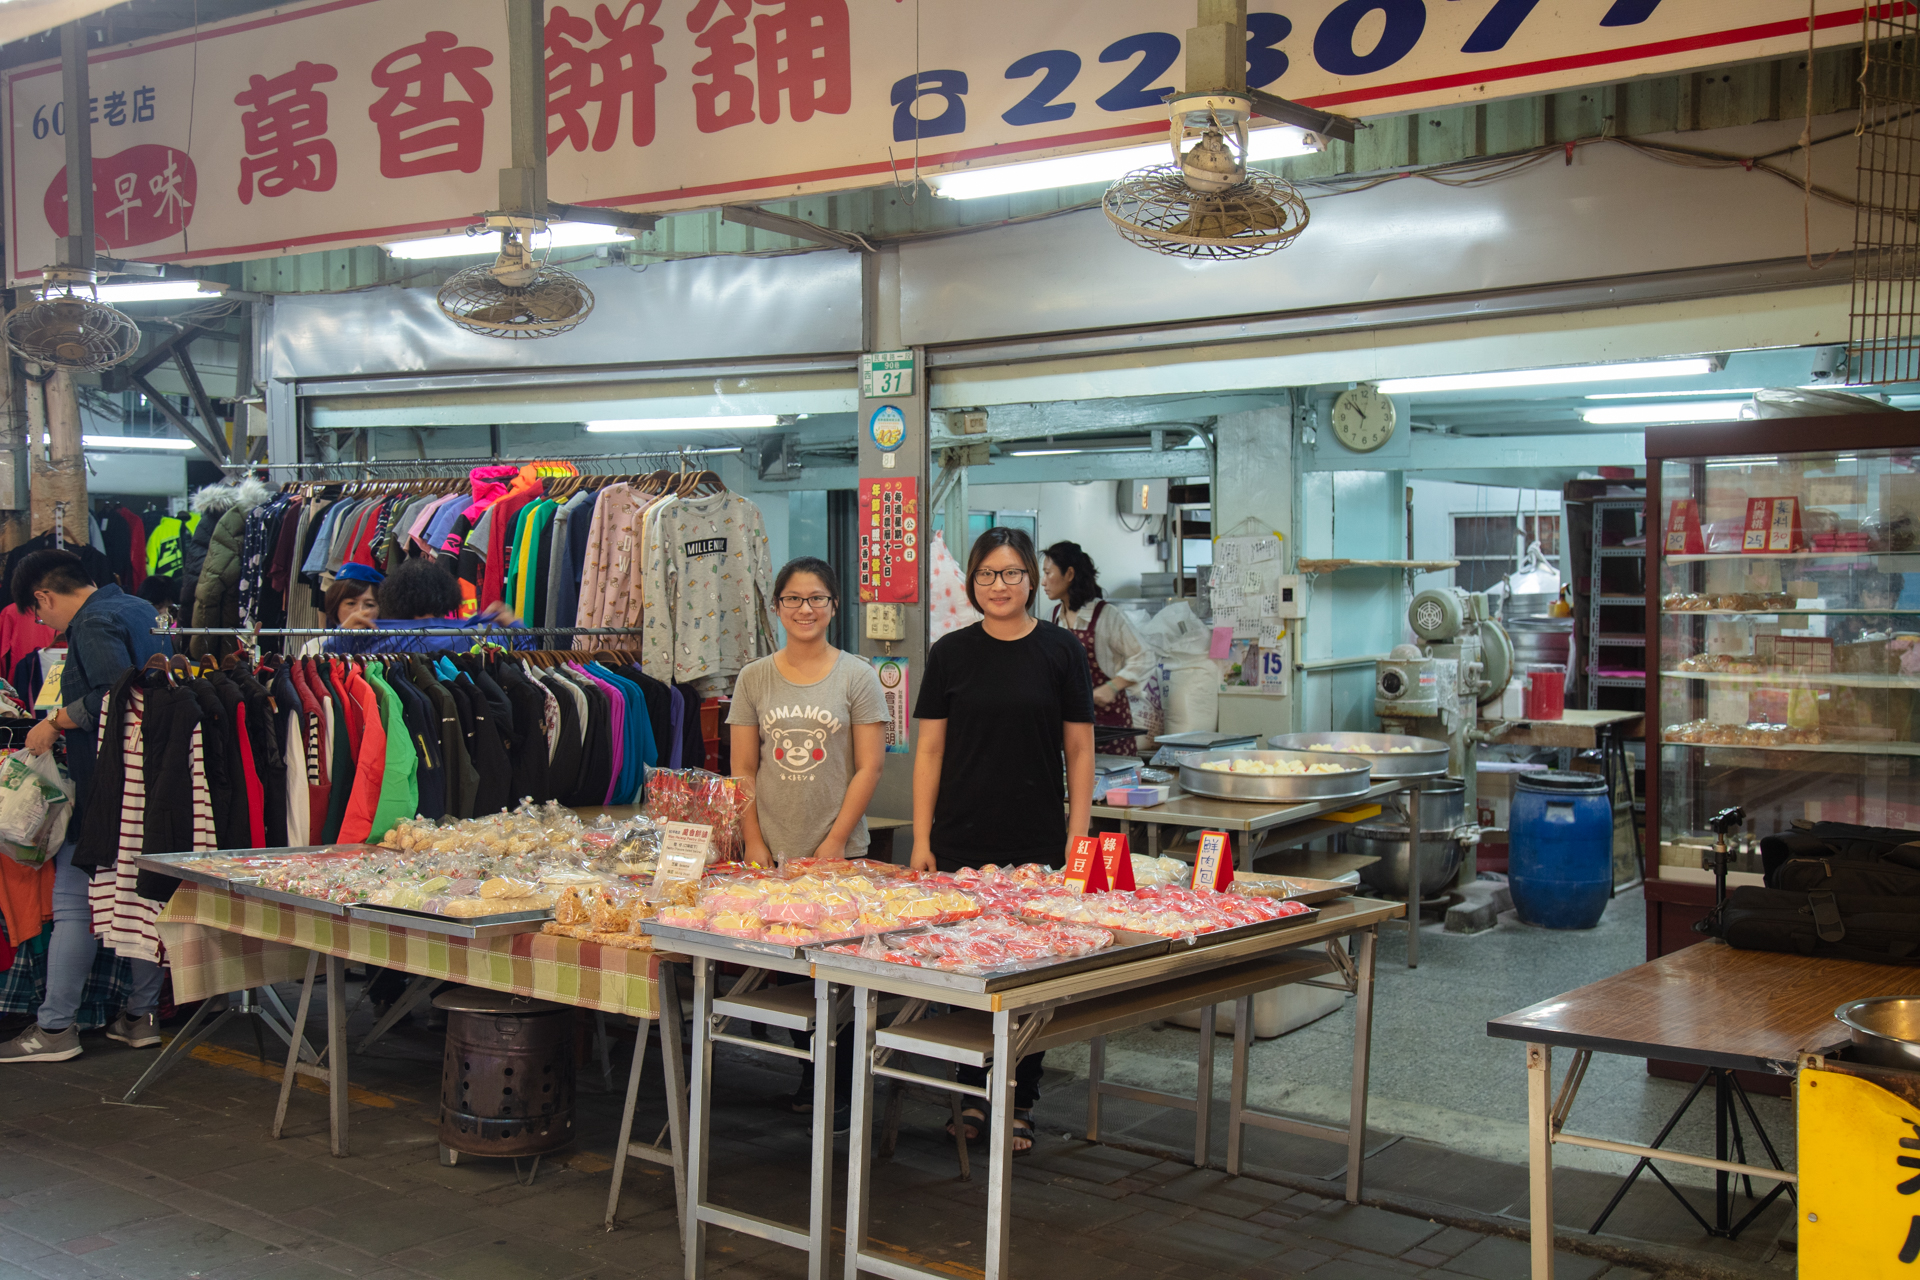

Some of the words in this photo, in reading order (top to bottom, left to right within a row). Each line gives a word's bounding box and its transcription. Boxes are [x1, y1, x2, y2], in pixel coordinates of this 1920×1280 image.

[1001, 0, 1661, 127] 2207
[234, 0, 851, 206] 萬香餅舖
[62, 150, 192, 240] 早味
[881, 372, 902, 393] 31
[905, 519, 914, 559] 公休日
[1669, 534, 1683, 544] 30
[1747, 535, 1762, 545] 25
[1772, 532, 1787, 543] 30
[1263, 652, 1282, 674] 15
[763, 704, 842, 734] KUMAMON
[1072, 840, 1091, 873] 紅豆
[1103, 837, 1116, 869] 綠豆
[1200, 837, 1219, 884] 鮮肉包
